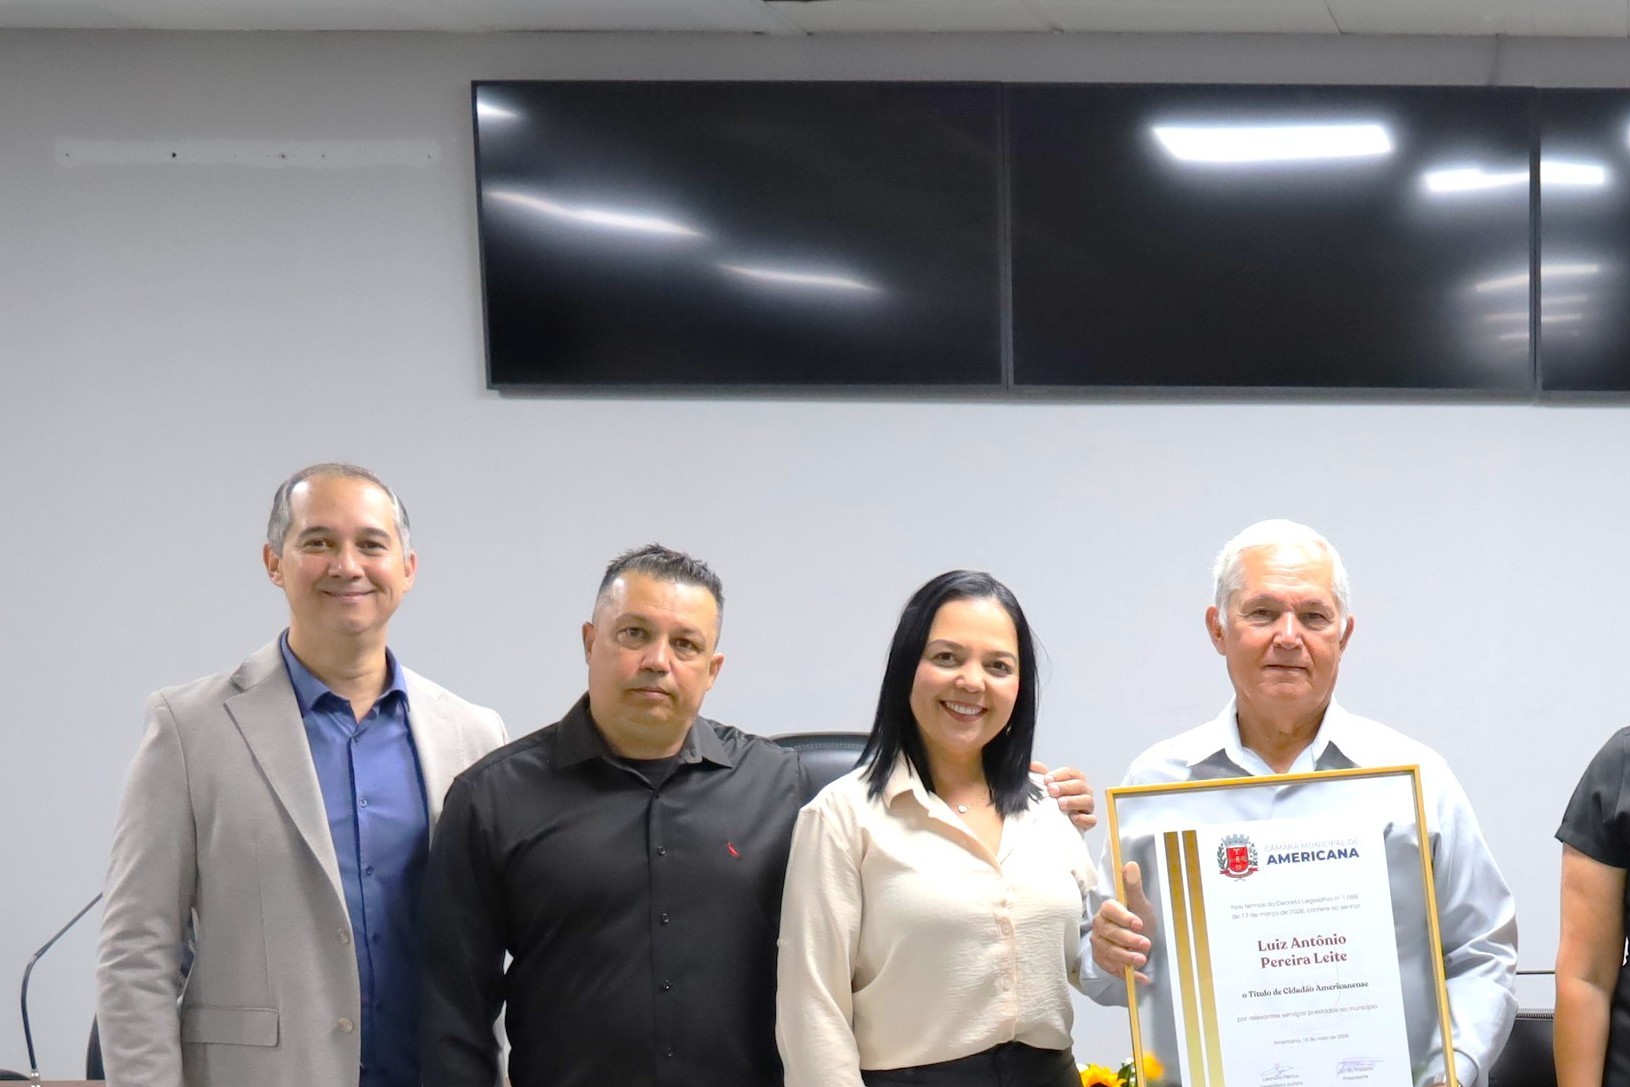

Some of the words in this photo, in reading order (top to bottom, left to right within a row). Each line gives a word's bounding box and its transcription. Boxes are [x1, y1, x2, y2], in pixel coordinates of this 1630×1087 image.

[1267, 848, 1359, 865] AMERICANA
[1258, 939, 1288, 952] Luiz
[1291, 933, 1347, 949] Antônio
[1261, 954, 1311, 968] Pereira
[1314, 951, 1348, 964] Leite
[1283, 986, 1314, 994] Cidadão
[1316, 981, 1368, 991] Americanense
